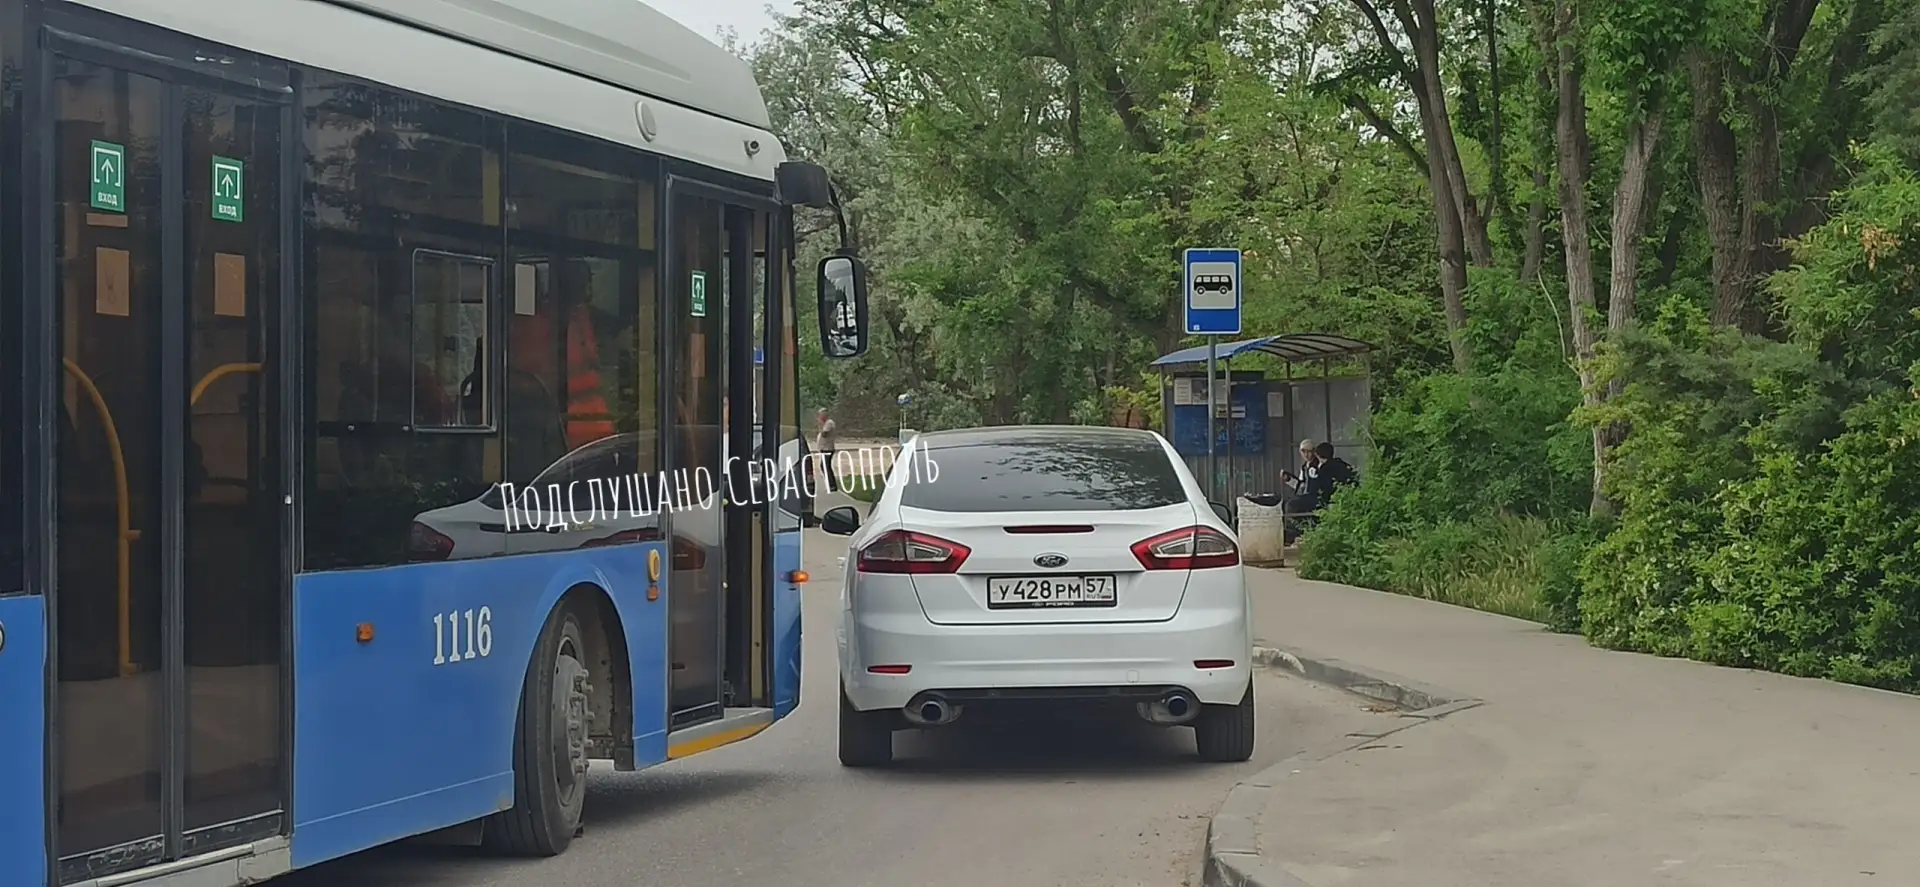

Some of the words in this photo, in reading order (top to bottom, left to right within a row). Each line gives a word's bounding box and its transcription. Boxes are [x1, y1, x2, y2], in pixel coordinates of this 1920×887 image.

[98, 192, 117, 206] ВХОД
[218, 203, 237, 217] ВХОД
[1086, 578, 1106, 593] 57
[433, 605, 492, 665] 1116
